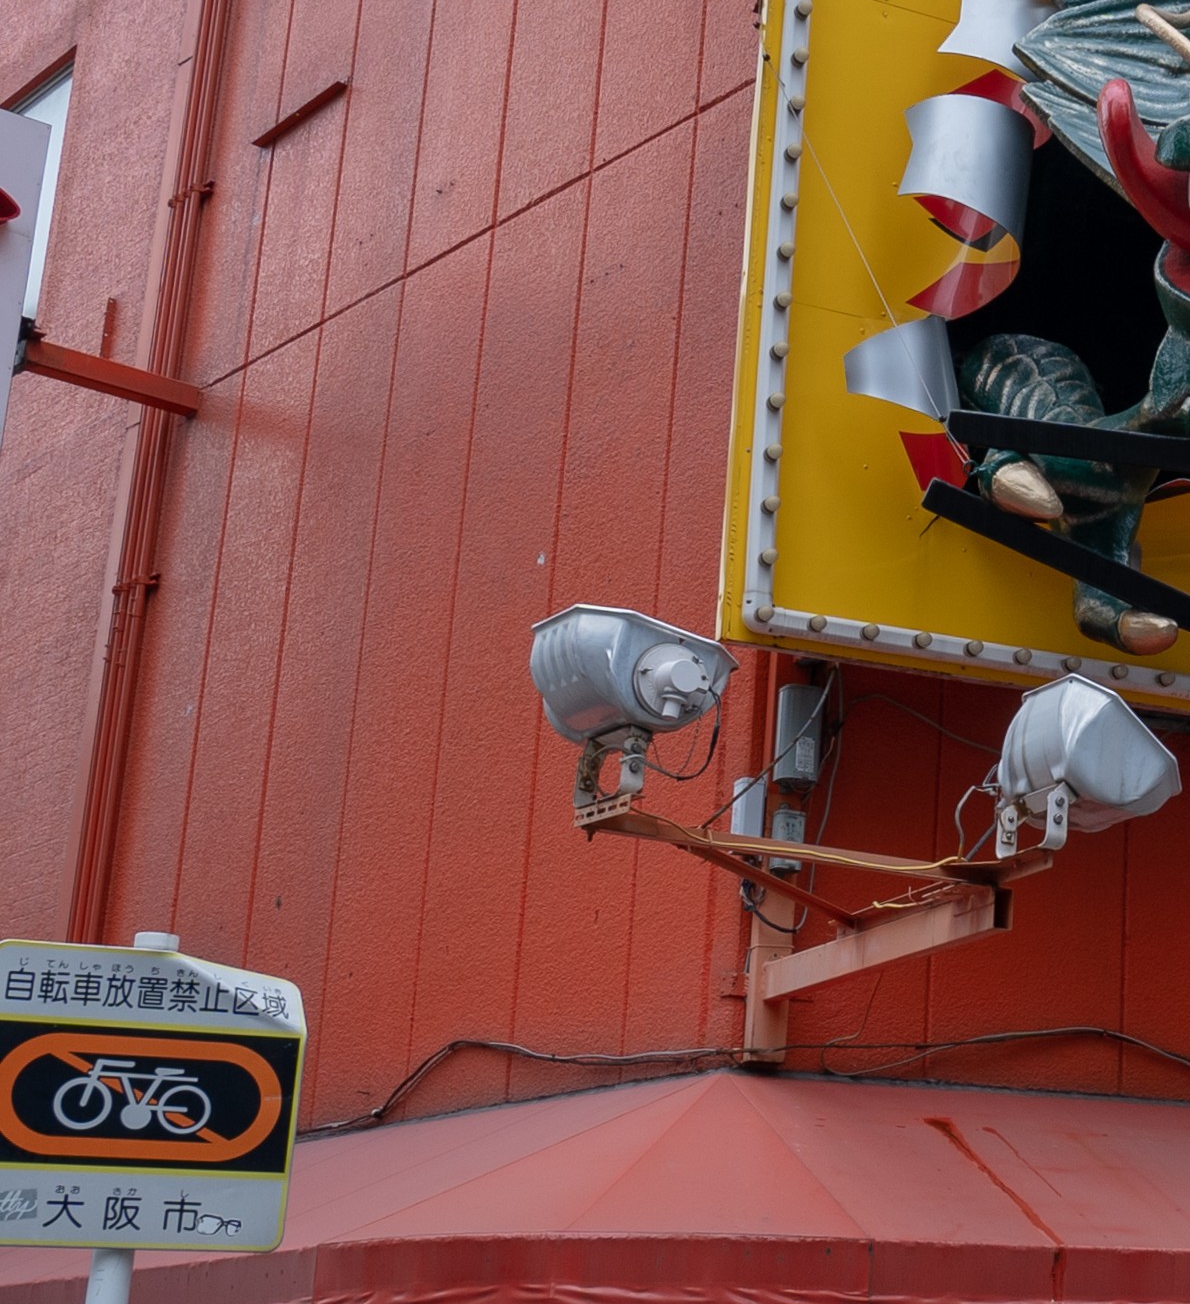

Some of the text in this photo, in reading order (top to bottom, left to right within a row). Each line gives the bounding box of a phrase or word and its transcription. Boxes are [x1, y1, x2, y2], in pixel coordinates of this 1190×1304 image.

[5, 967, 289, 1019] 自転車放置禁止区域
[42, 1193, 202, 1234] 大阪市
